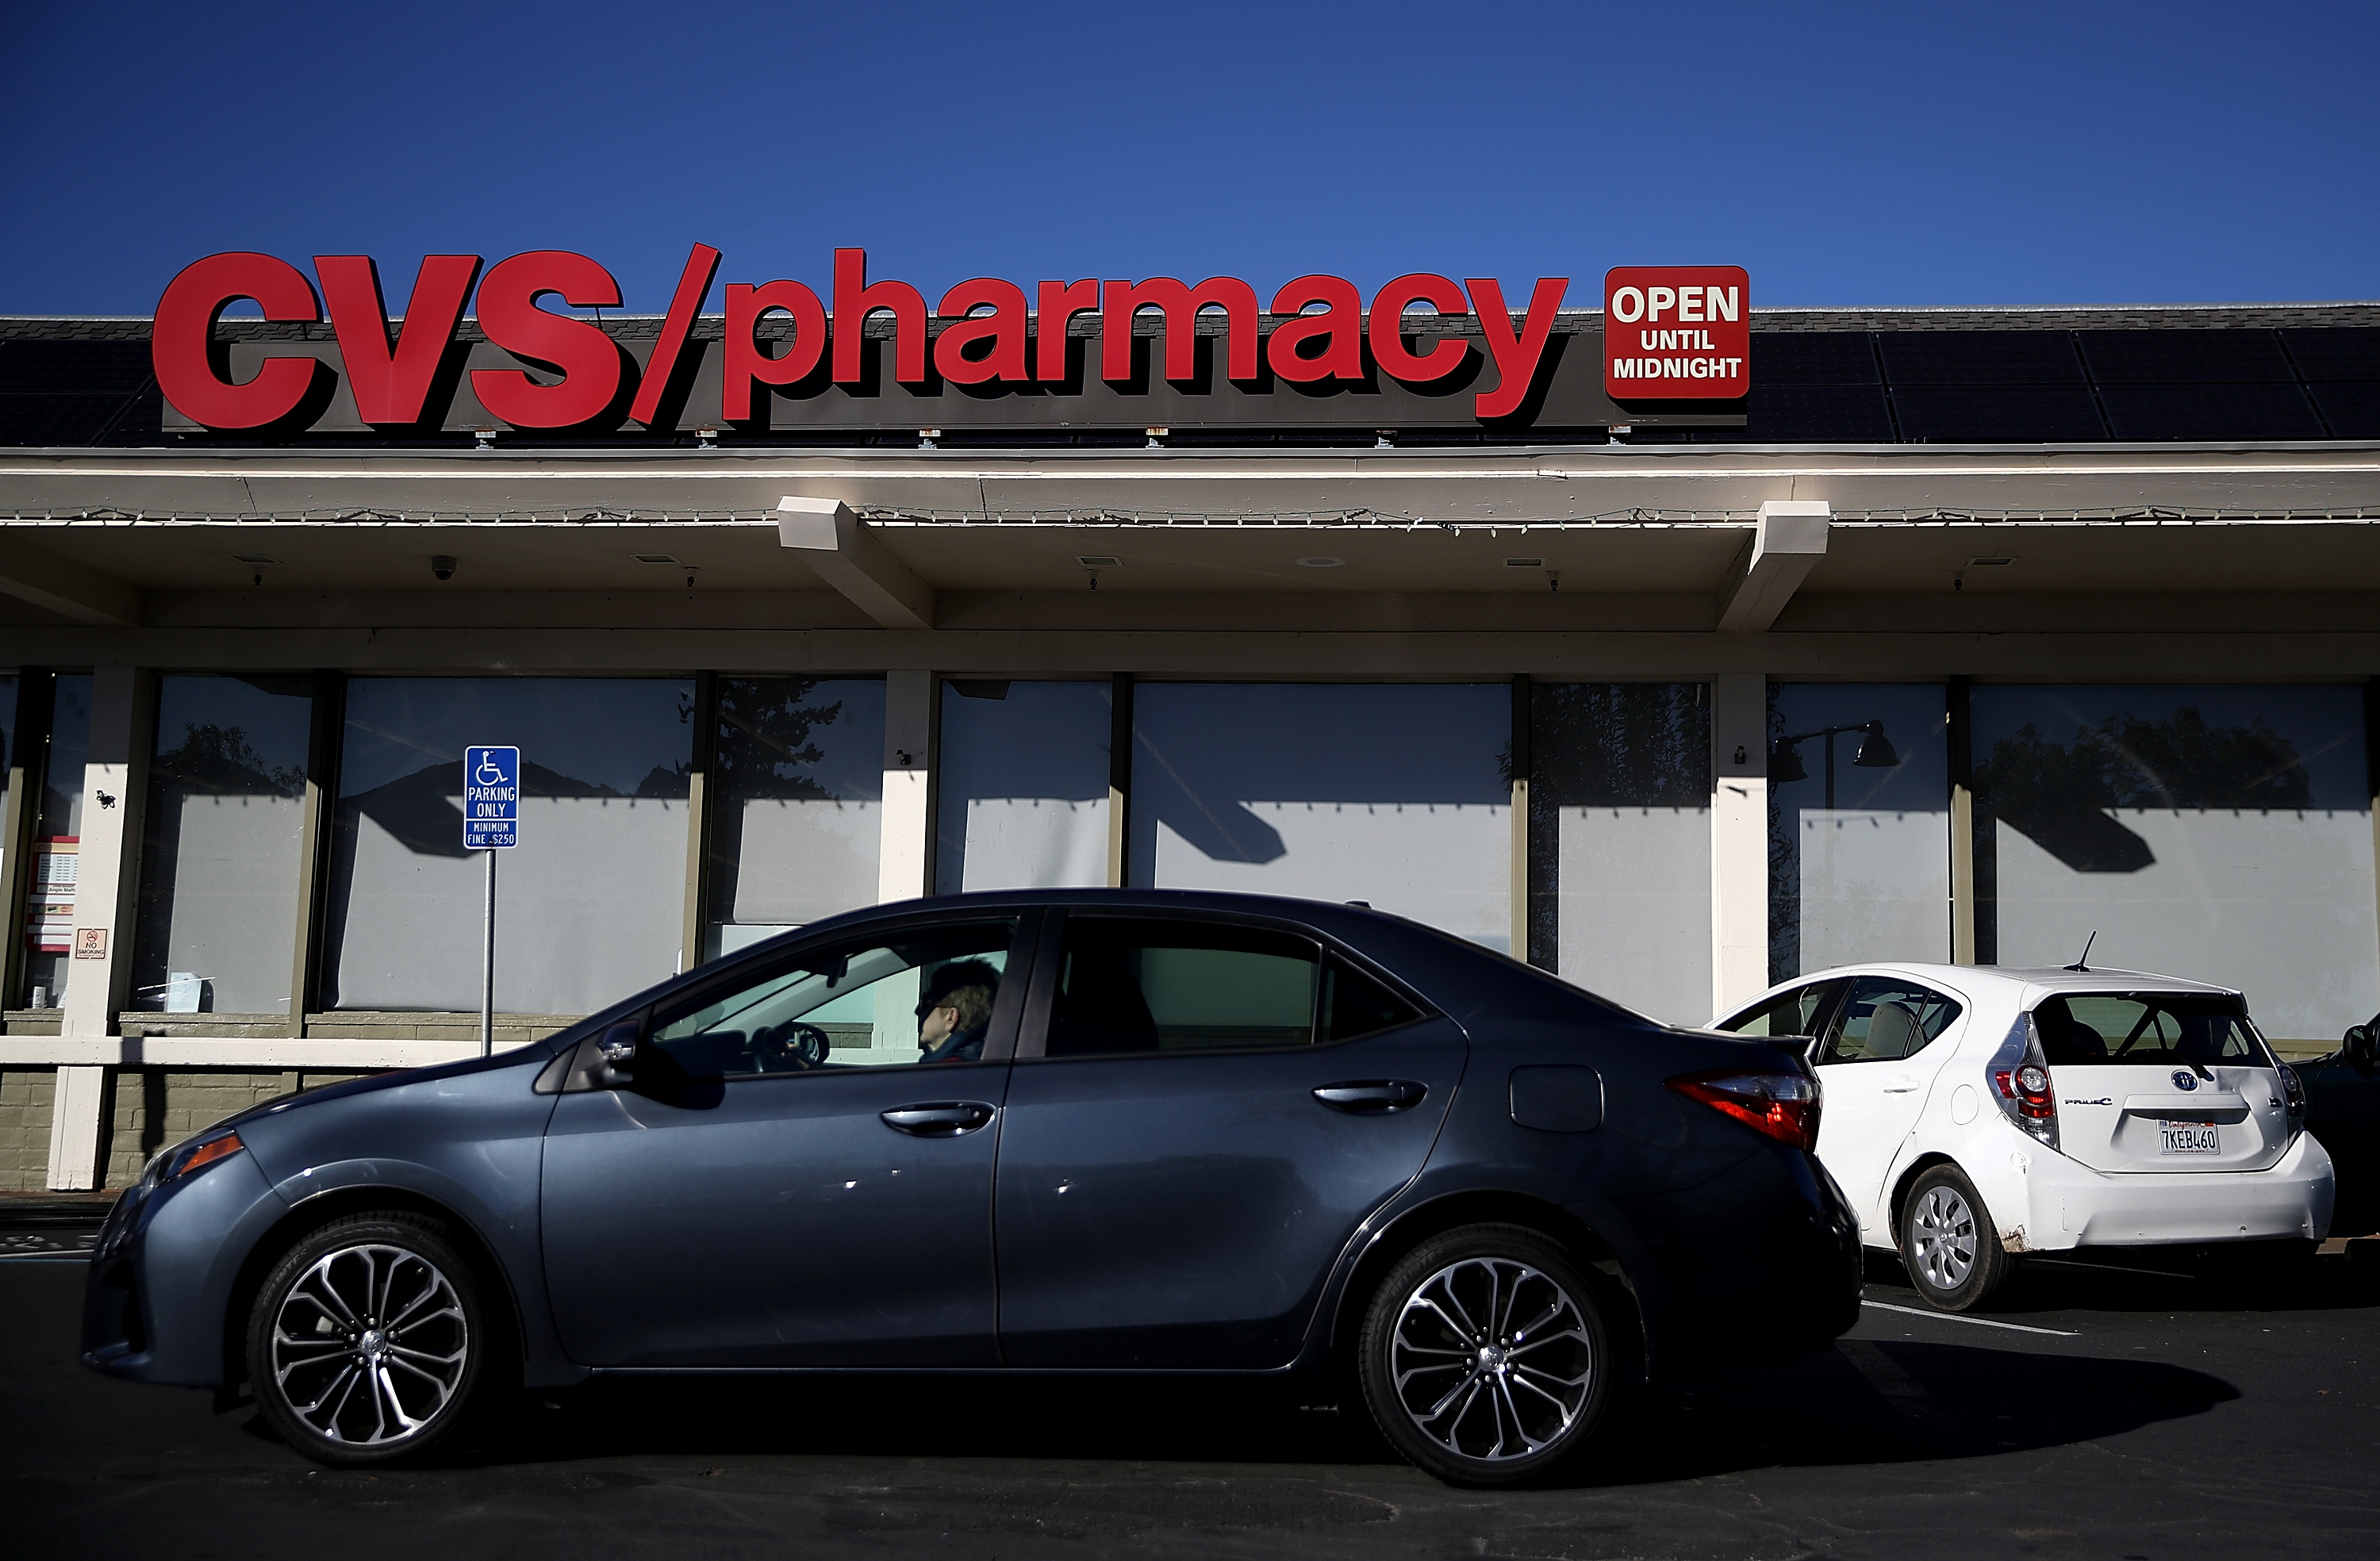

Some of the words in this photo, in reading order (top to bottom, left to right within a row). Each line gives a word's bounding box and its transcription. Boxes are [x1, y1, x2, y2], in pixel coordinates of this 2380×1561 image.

[1611, 286, 1739, 323] OPEN
[152, 242, 1569, 429] CVS/pharmacy
[1641, 330, 1715, 351] UNTIL
[1614, 357, 1742, 379] MIDNIGHT
[468, 787, 515, 801] PARKING
[477, 803, 506, 817] ONLY
[474, 823, 509, 832] MINIMUM
[467, 834, 486, 844] FINE
[493, 834, 515, 844] $250
[2161, 1130, 2216, 1149] 7KEB460
